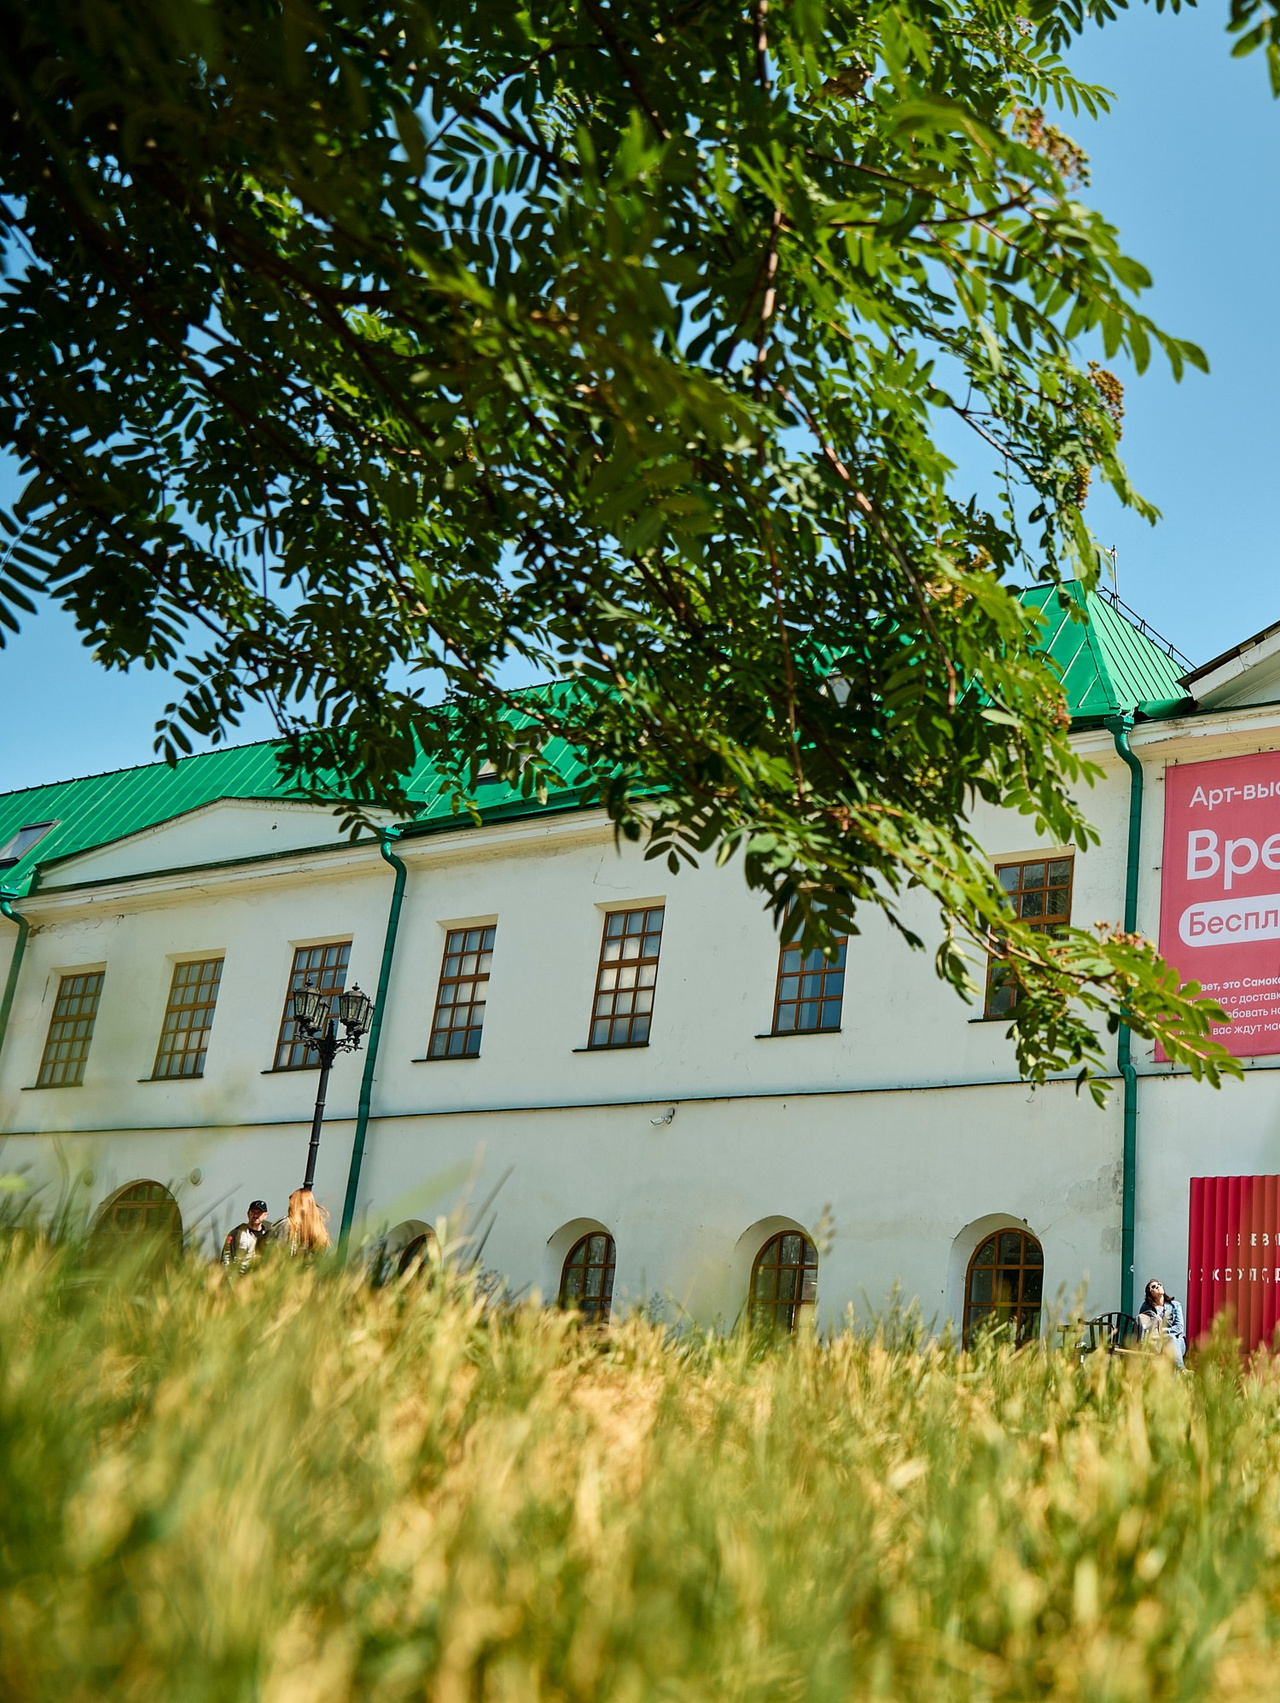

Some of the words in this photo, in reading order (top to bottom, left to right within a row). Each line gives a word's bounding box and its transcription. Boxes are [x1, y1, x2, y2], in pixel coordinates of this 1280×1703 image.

[1180, 982, 1221, 994] вет,
[1222, 980, 1240, 990] это
[1230, 995, 1237, 1004] с
[1213, 1026, 1232, 1036] вас
[1234, 1024, 1261, 1035] ждут
